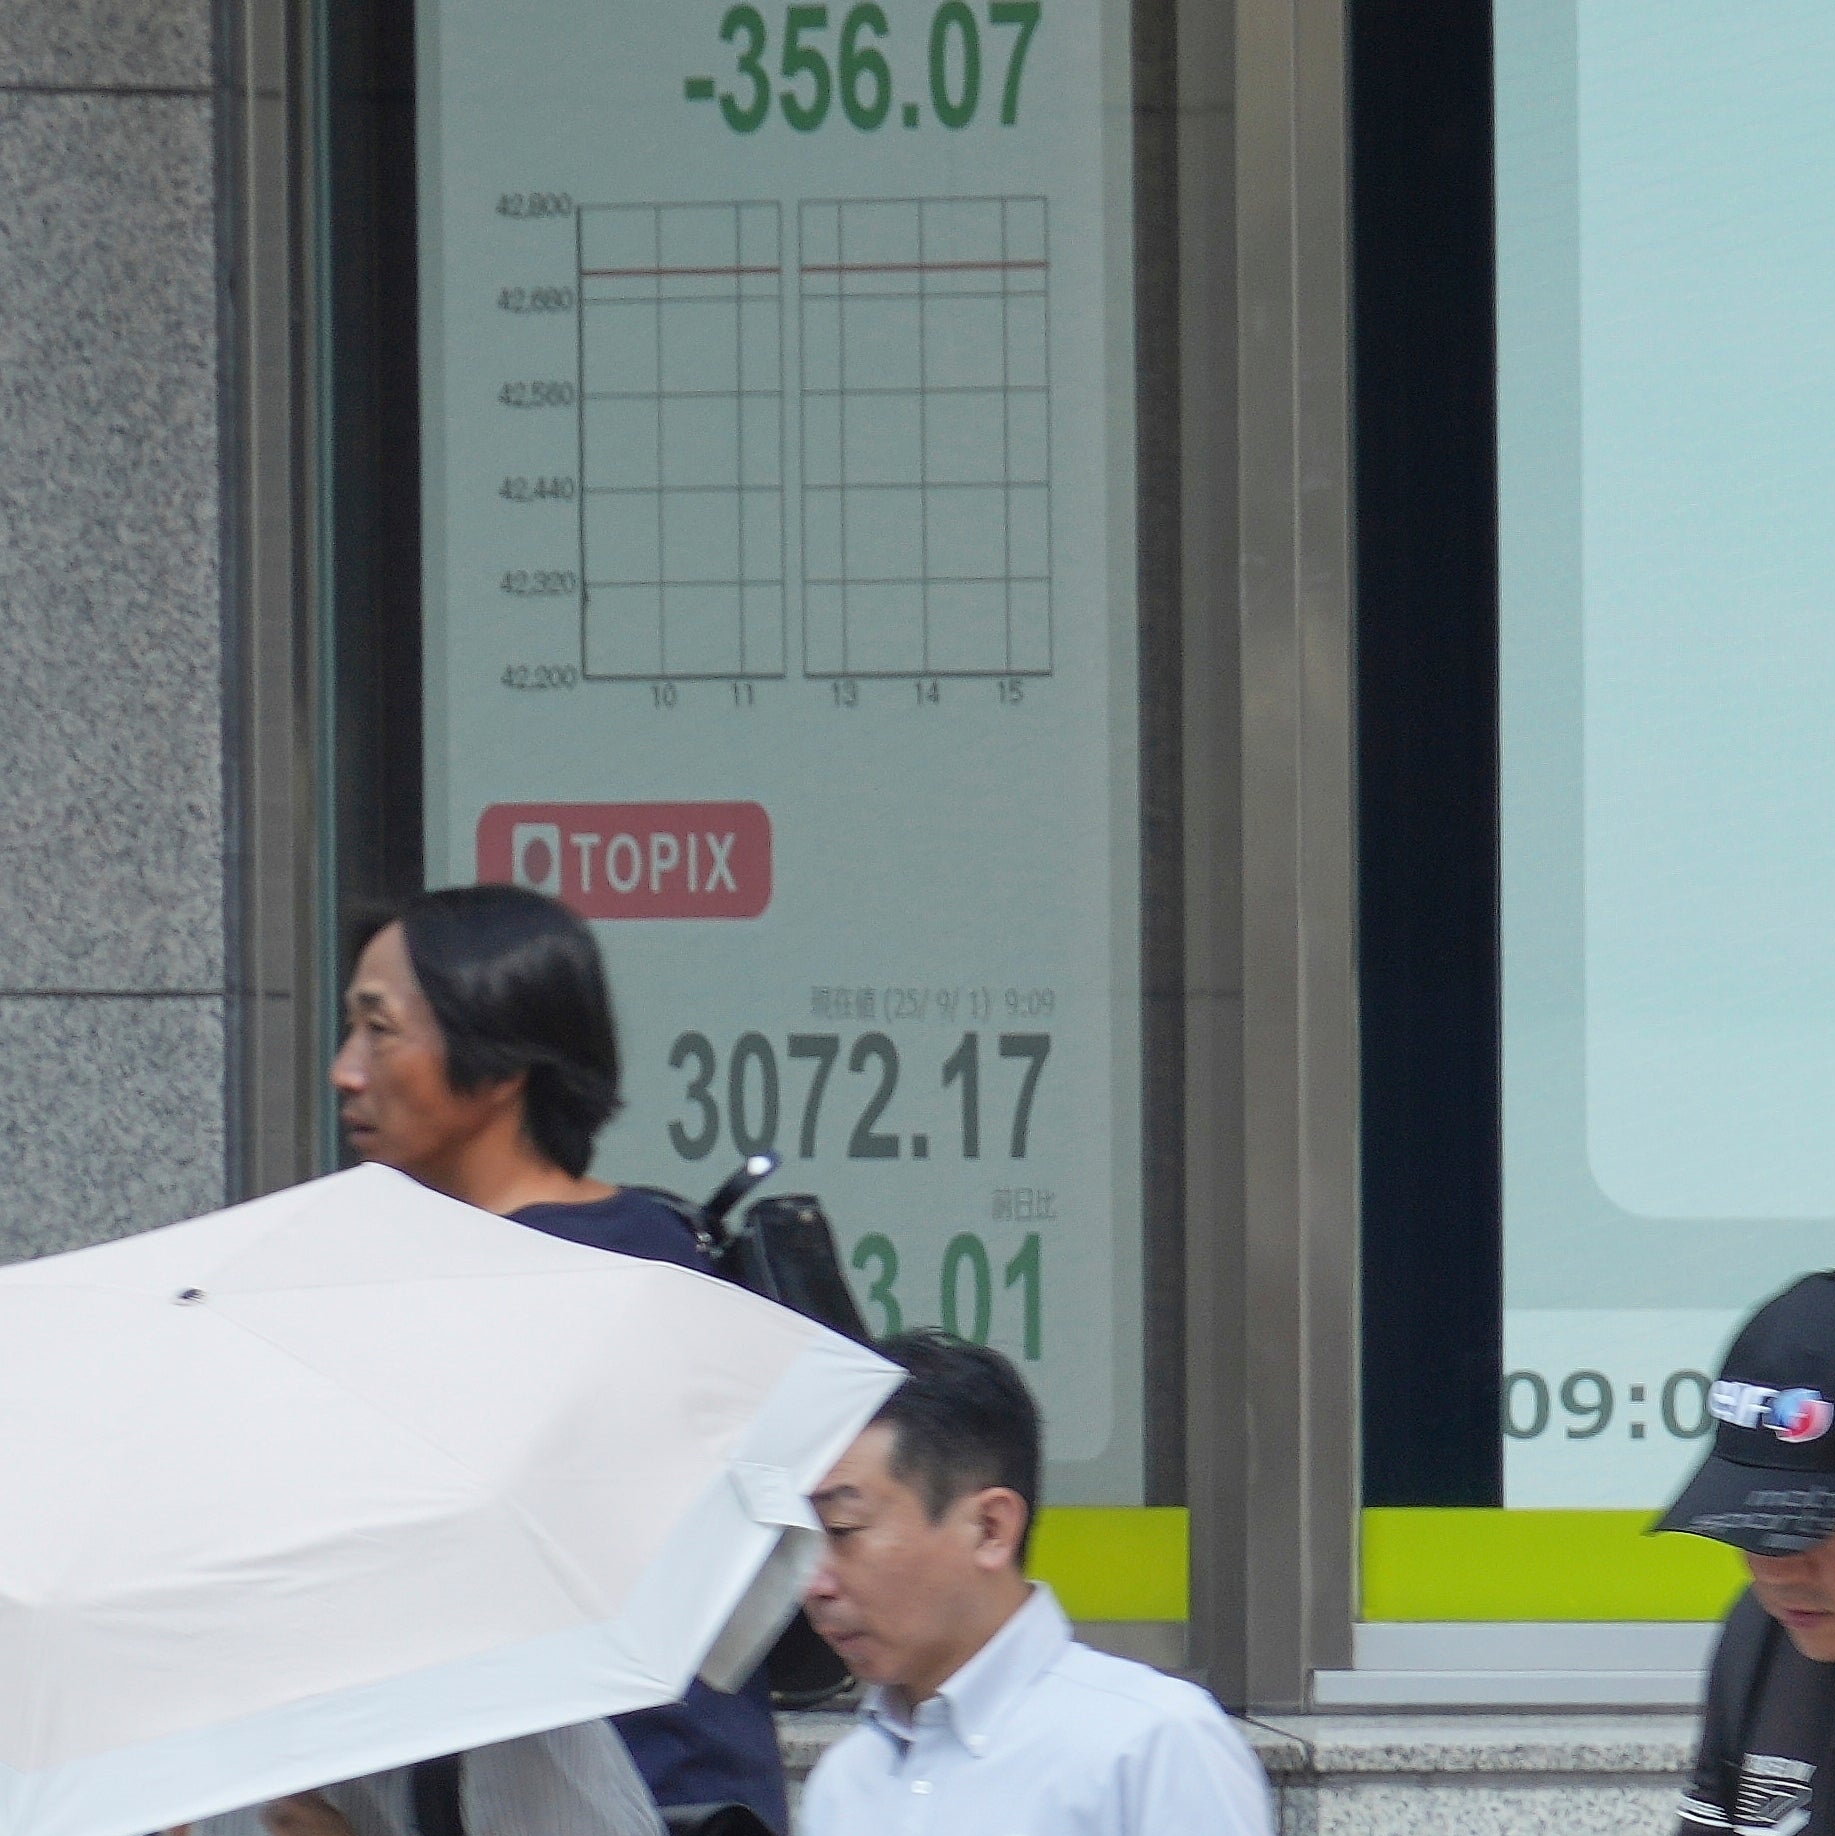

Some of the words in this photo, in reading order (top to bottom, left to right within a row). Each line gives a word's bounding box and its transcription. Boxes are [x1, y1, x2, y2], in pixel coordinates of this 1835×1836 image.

[684, 1, 1042, 133] -356.07
[499, 475, 576, 504] 42,440
[501, 664, 577, 692] 42,200
[652, 683, 677, 708] 10
[732, 683, 755, 707] 11
[833, 683, 859, 708] 13
[916, 682, 941, 706] 14
[999, 682, 1024, 706] 15
[571, 832, 738, 894] TOPIX
[667, 1031, 1052, 1160] 3072.17
[1502, 1369, 1714, 1440] 09:0
